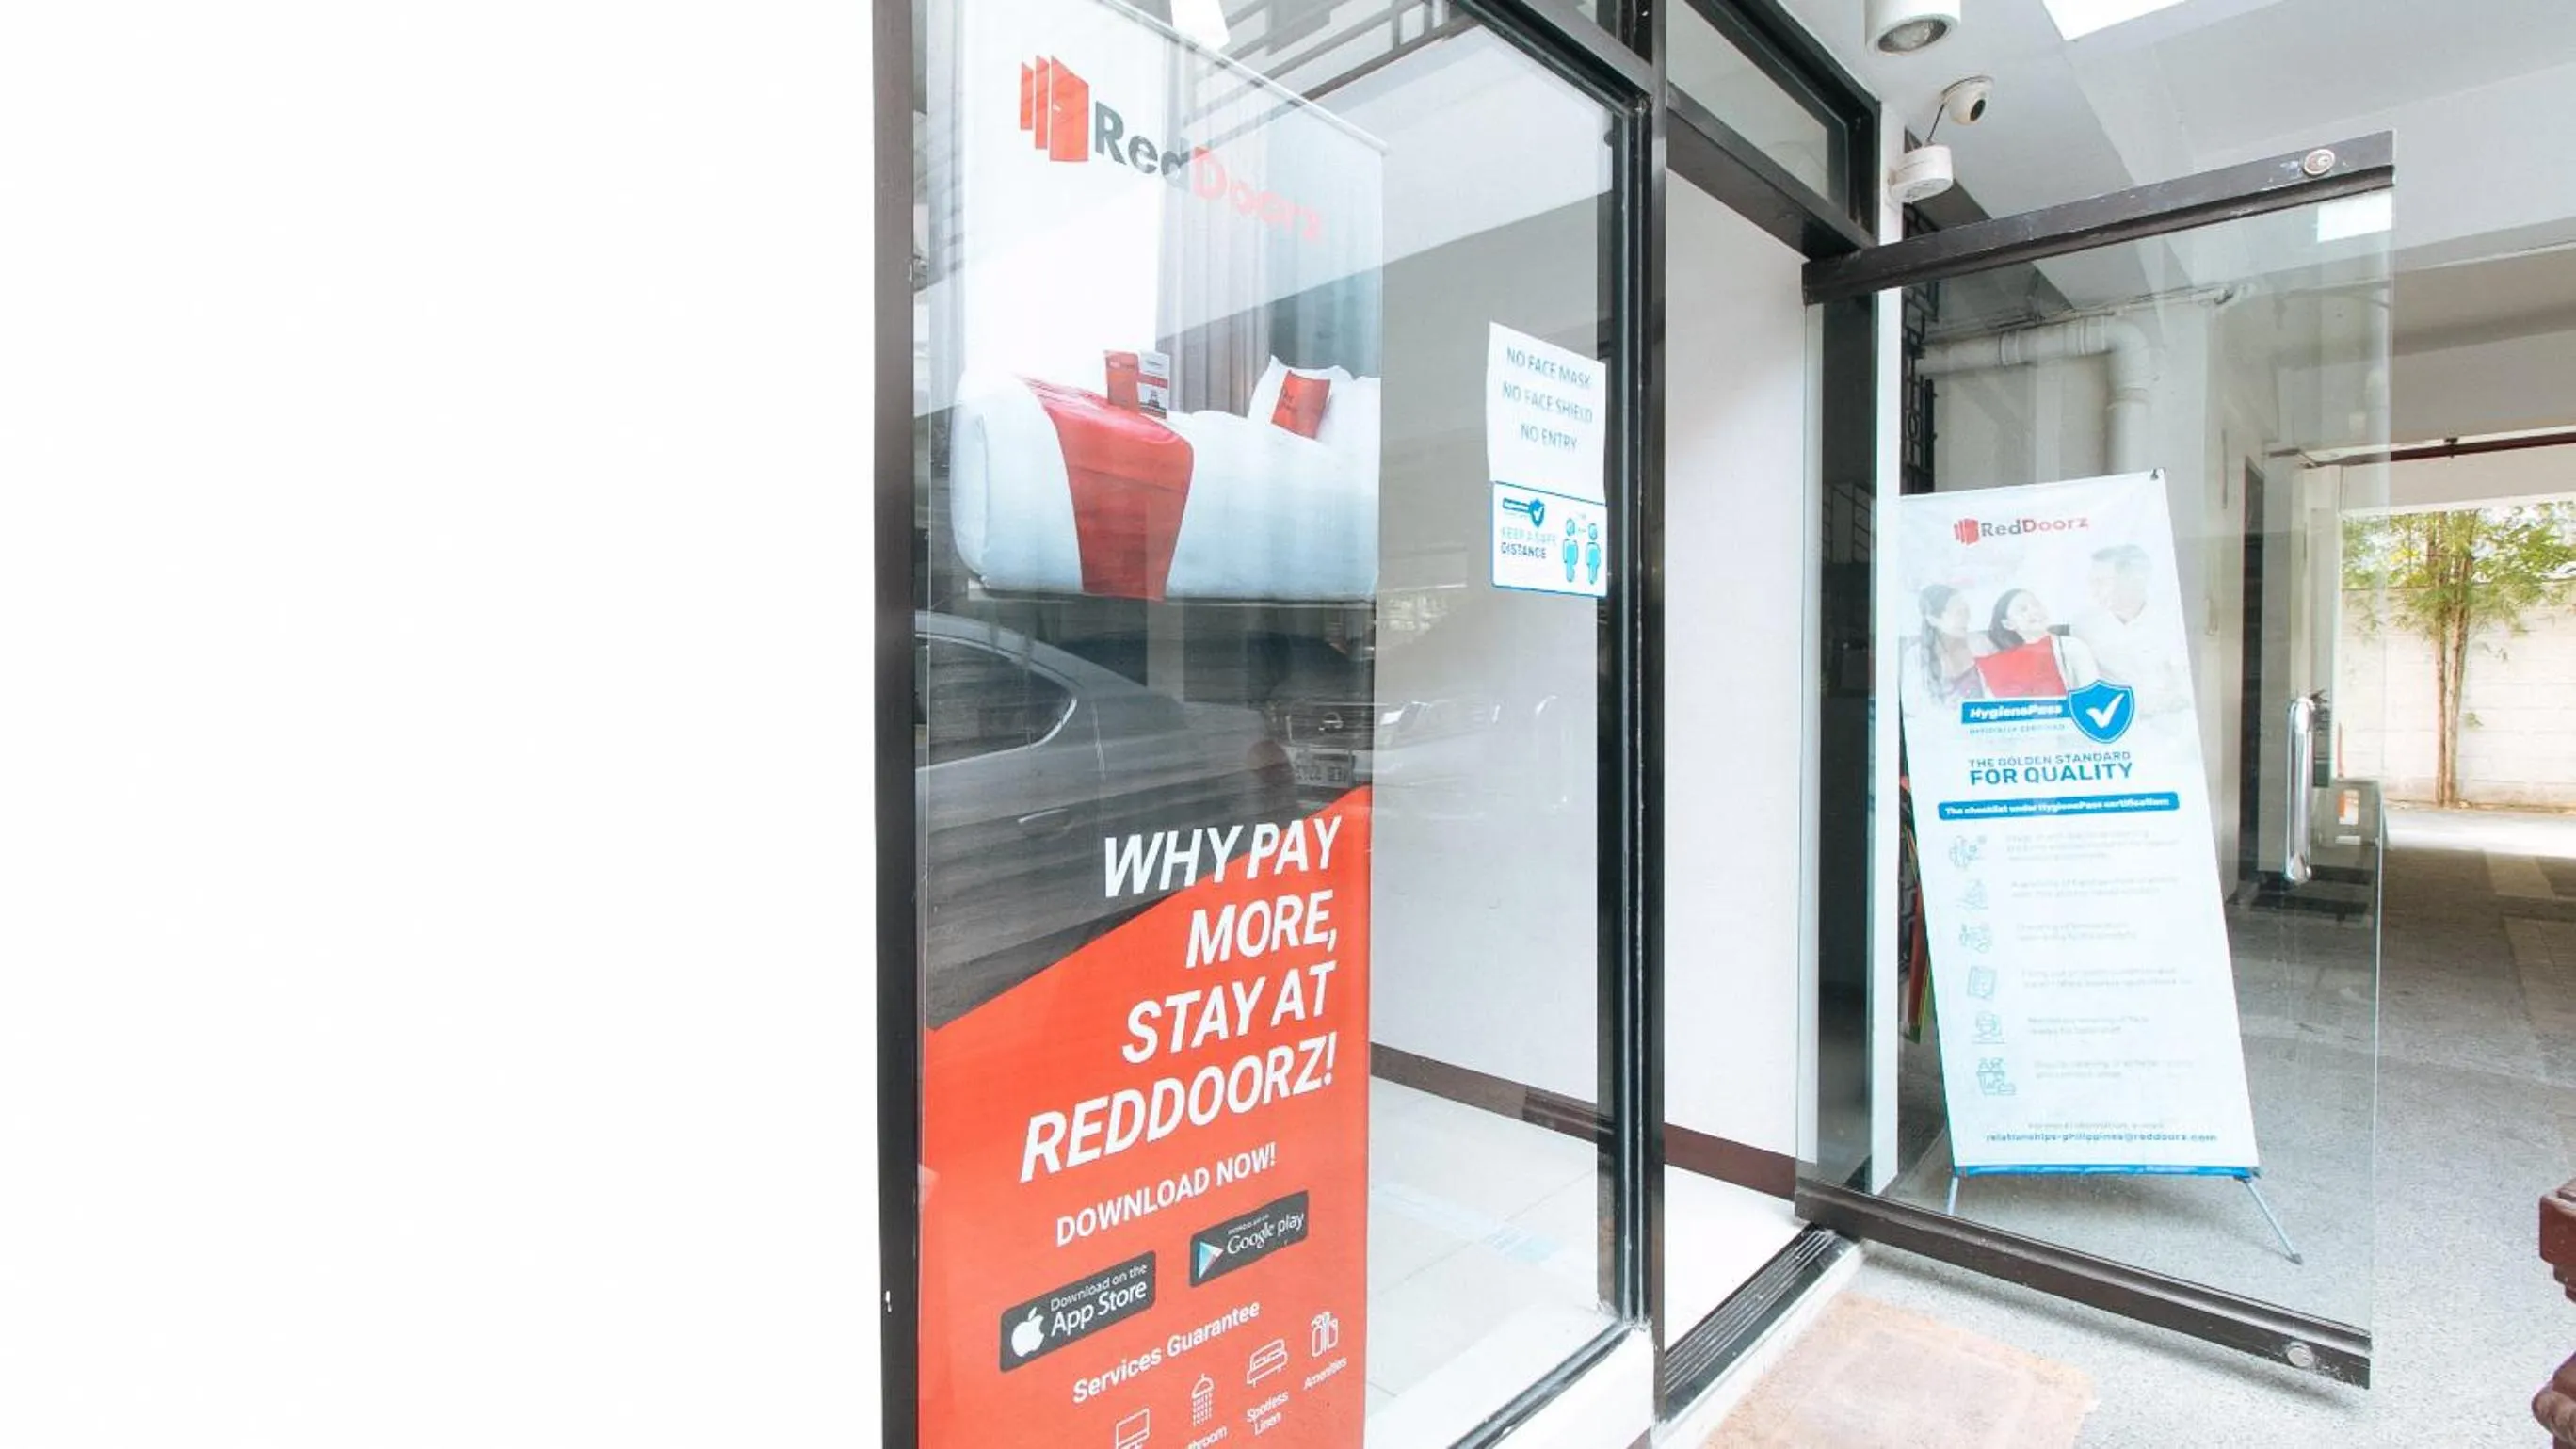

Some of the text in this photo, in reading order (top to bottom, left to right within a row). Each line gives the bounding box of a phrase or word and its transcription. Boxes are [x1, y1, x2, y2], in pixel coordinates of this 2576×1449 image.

[1095, 101, 1322, 245] RedDoorz
[1506, 346, 1591, 389] NO FACE MASK
[1503, 380, 1593, 423] NO FACE SHIELD
[1521, 423, 1578, 451] NO ENTRY
[1981, 516, 2089, 539] RedDoorz
[1501, 541, 1547, 559] DISTANCE
[1969, 751, 2132, 768] THE GOLDEN STANDARD
[1970, 762, 2133, 786] FOR QUALITY
[1104, 816, 1342, 898] WHY PAY
[1185, 889, 1337, 969] MORE,
[1121, 960, 1337, 1064] STAY AT
[1020, 1031, 1338, 1183] REDDOORZ!
[1055, 1141, 1278, 1248] DOWNLOAD NOW!
[1227, 1222, 1275, 1254] Google
[1278, 1213, 1304, 1237] play
[1051, 1264, 1148, 1312] Download on the
[1051, 1281, 1148, 1337] App Store
[1072, 1301, 1260, 1404] Services Guarantee
[1246, 1391, 1289, 1423] Spotless
[1254, 1411, 1281, 1436] Linen
